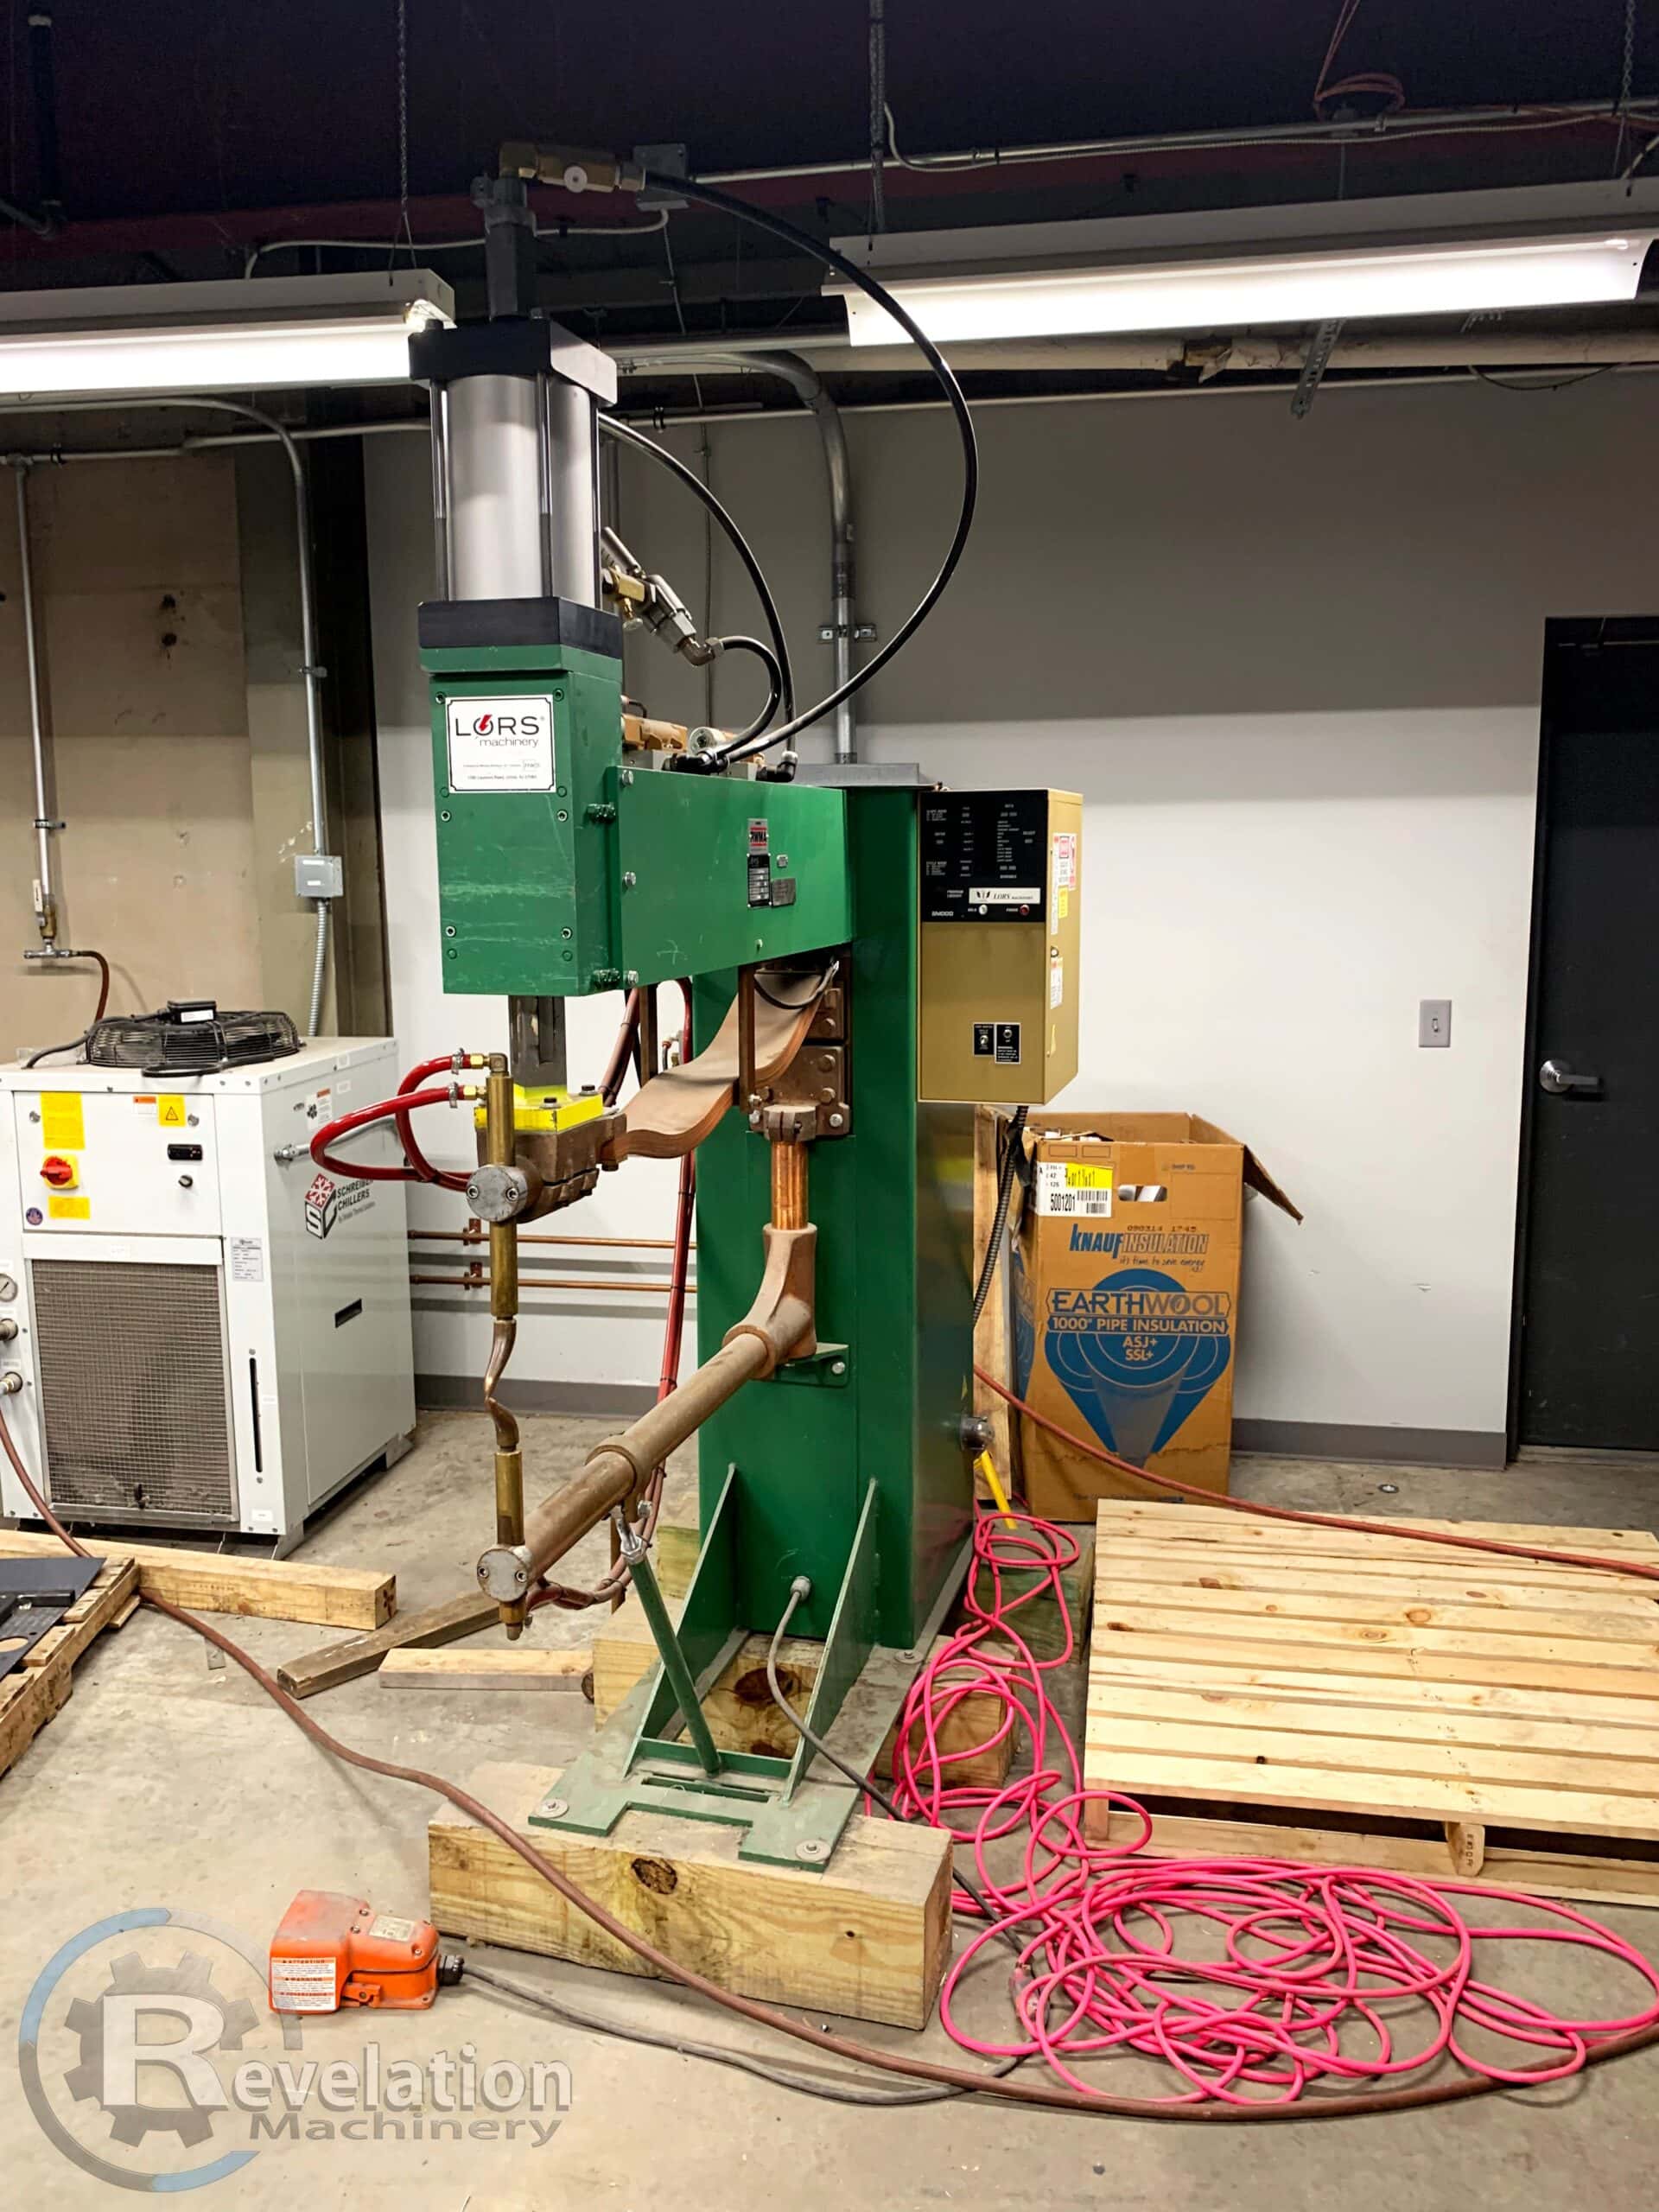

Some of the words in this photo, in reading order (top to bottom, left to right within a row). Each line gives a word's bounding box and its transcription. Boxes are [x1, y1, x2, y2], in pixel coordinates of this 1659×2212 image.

[455, 714, 540, 736] LORS
[479, 737, 539, 748] machinery
[338, 1189, 370, 1211] CHILLERS
[1050, 1193, 1076, 1211] 5001201
[1122, 1233, 1209, 1254] INSULATION
[1052, 1291, 1225, 1316] EARTHWOOL
[1096, 1319, 1128, 1332] PIPE
[1133, 1319, 1226, 1333] INSULATION
[1122, 1336, 1158, 1348] ASJ+
[1125, 1349, 1154, 1361] SSL+
